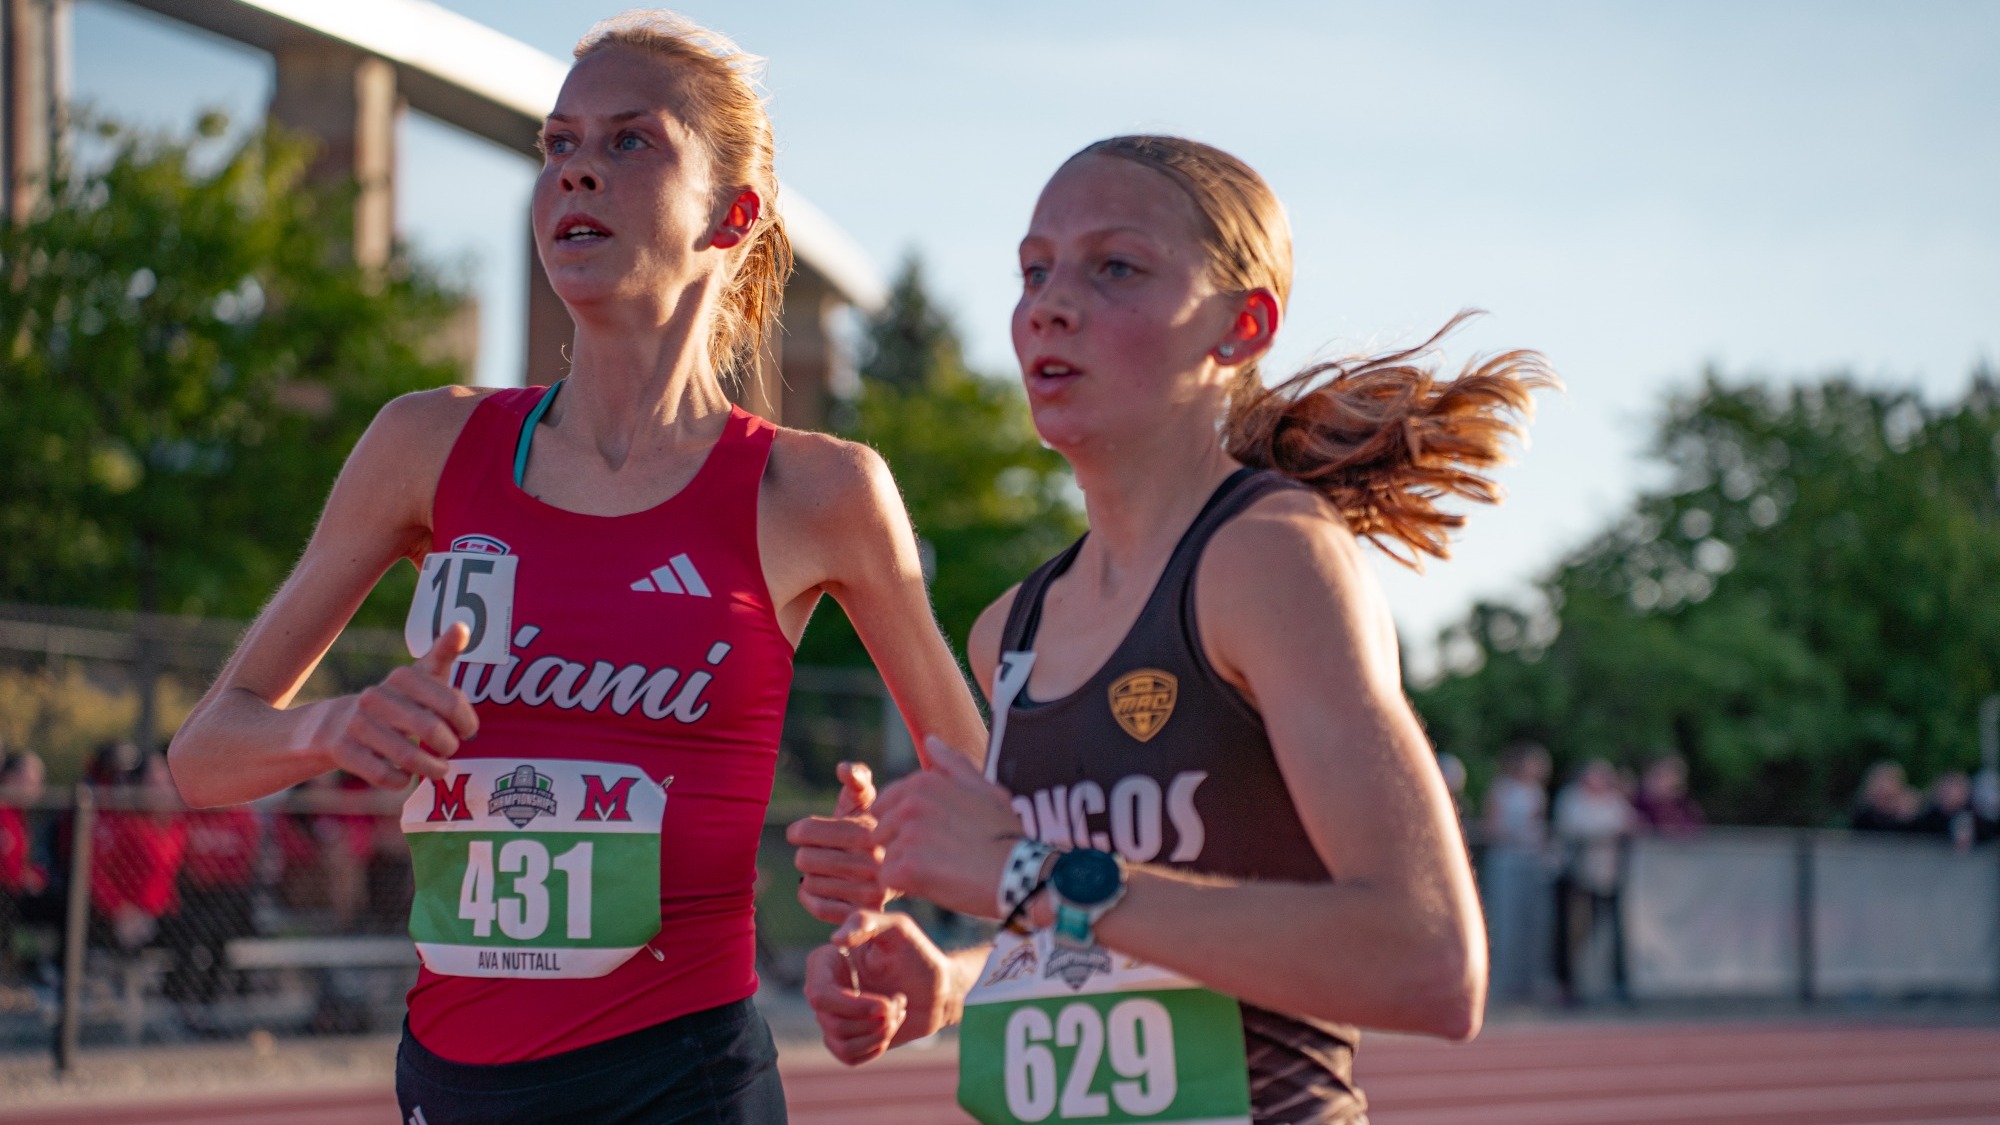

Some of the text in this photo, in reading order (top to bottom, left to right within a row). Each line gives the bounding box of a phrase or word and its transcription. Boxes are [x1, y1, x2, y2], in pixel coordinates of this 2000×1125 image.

[431, 558, 495, 654] 15
[450, 624, 732, 724] iami
[575, 774, 641, 822] M
[458, 839, 594, 940] 431
[477, 951, 561, 971] AVA NUTTALL
[1004, 997, 1178, 1123] 629
